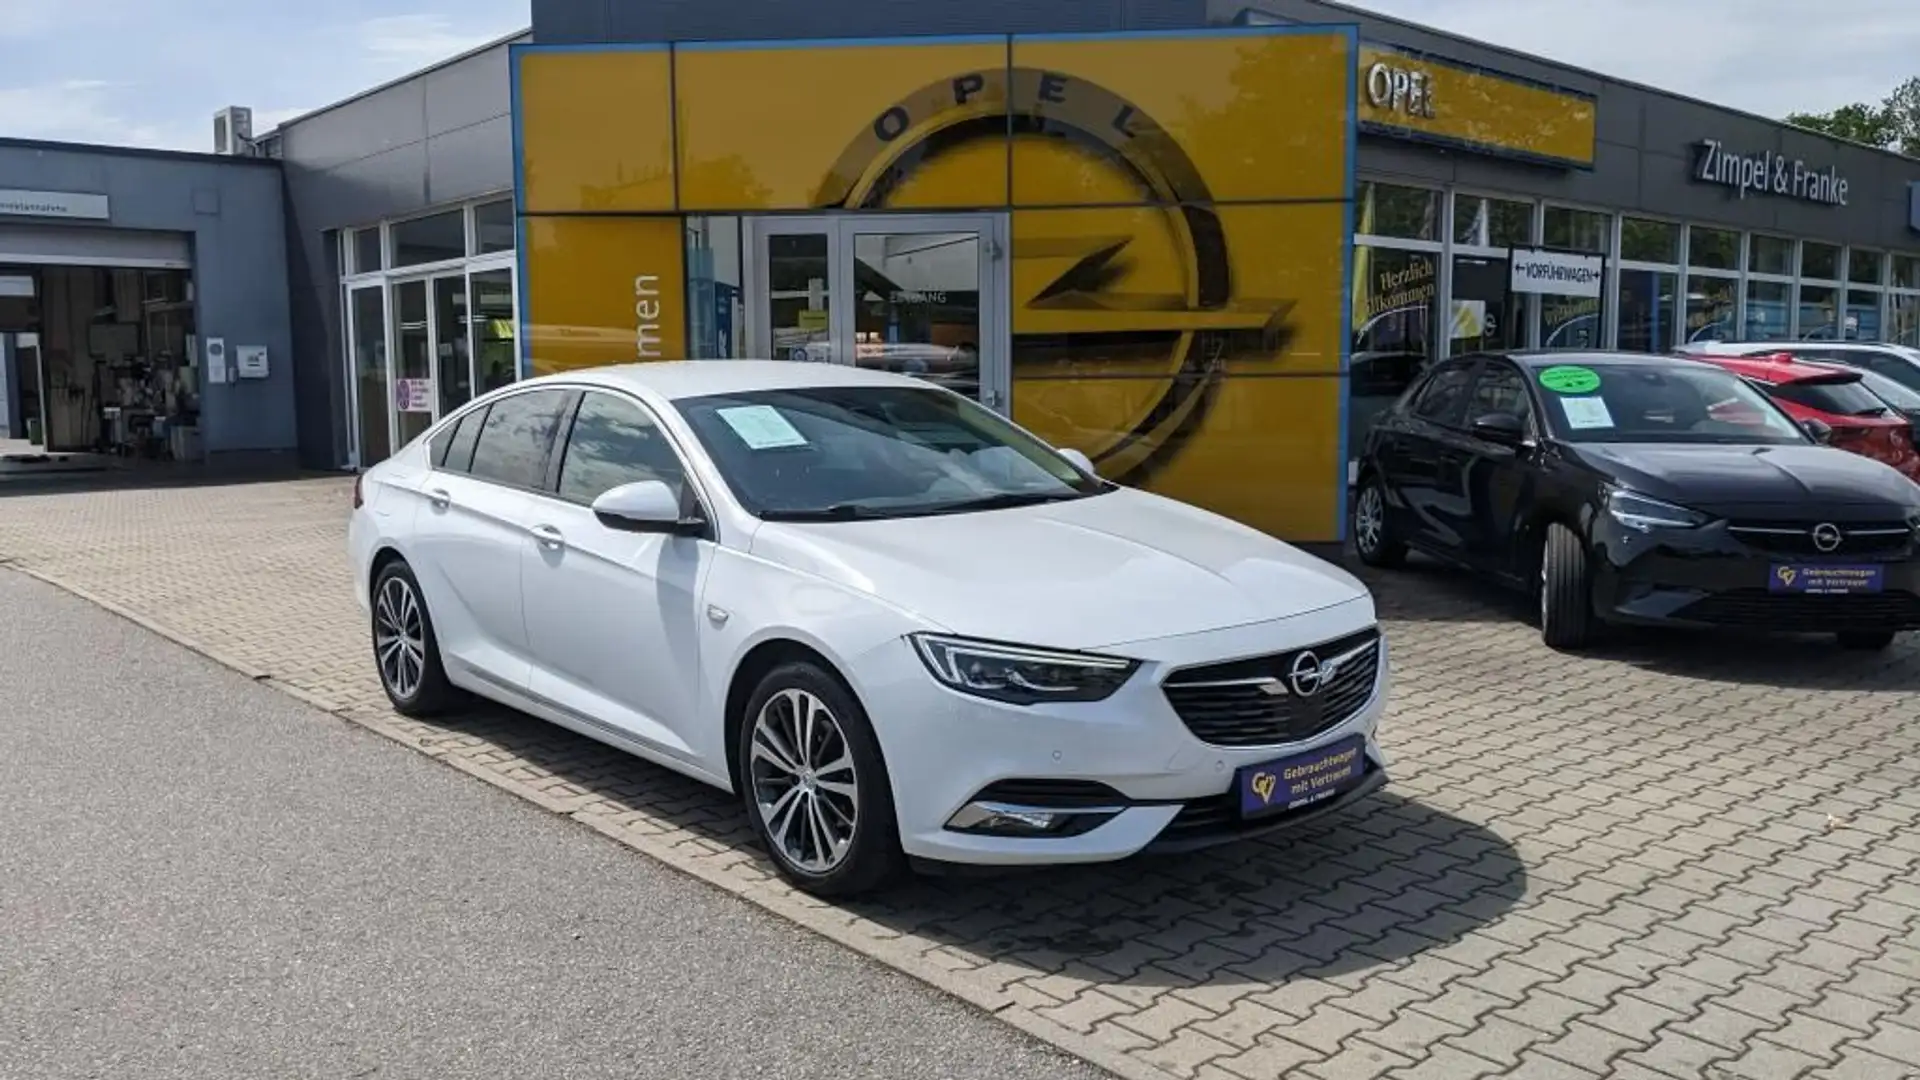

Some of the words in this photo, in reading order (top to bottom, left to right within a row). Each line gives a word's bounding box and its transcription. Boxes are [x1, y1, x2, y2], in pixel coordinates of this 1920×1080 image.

[874, 72, 1136, 143] OPEL
[1368, 63, 1435, 118] OPEL
[1702, 138, 1770, 199] Zimpel
[1774, 155, 1788, 194] &
[1793, 160, 1849, 206] Franke
[1380, 258, 1434, 291] Herzlich
[1283, 747, 1357, 780] Gebrauchtwagen
[1291, 779, 1309, 795] mit
[1310, 765, 1352, 789] Vertrauen
